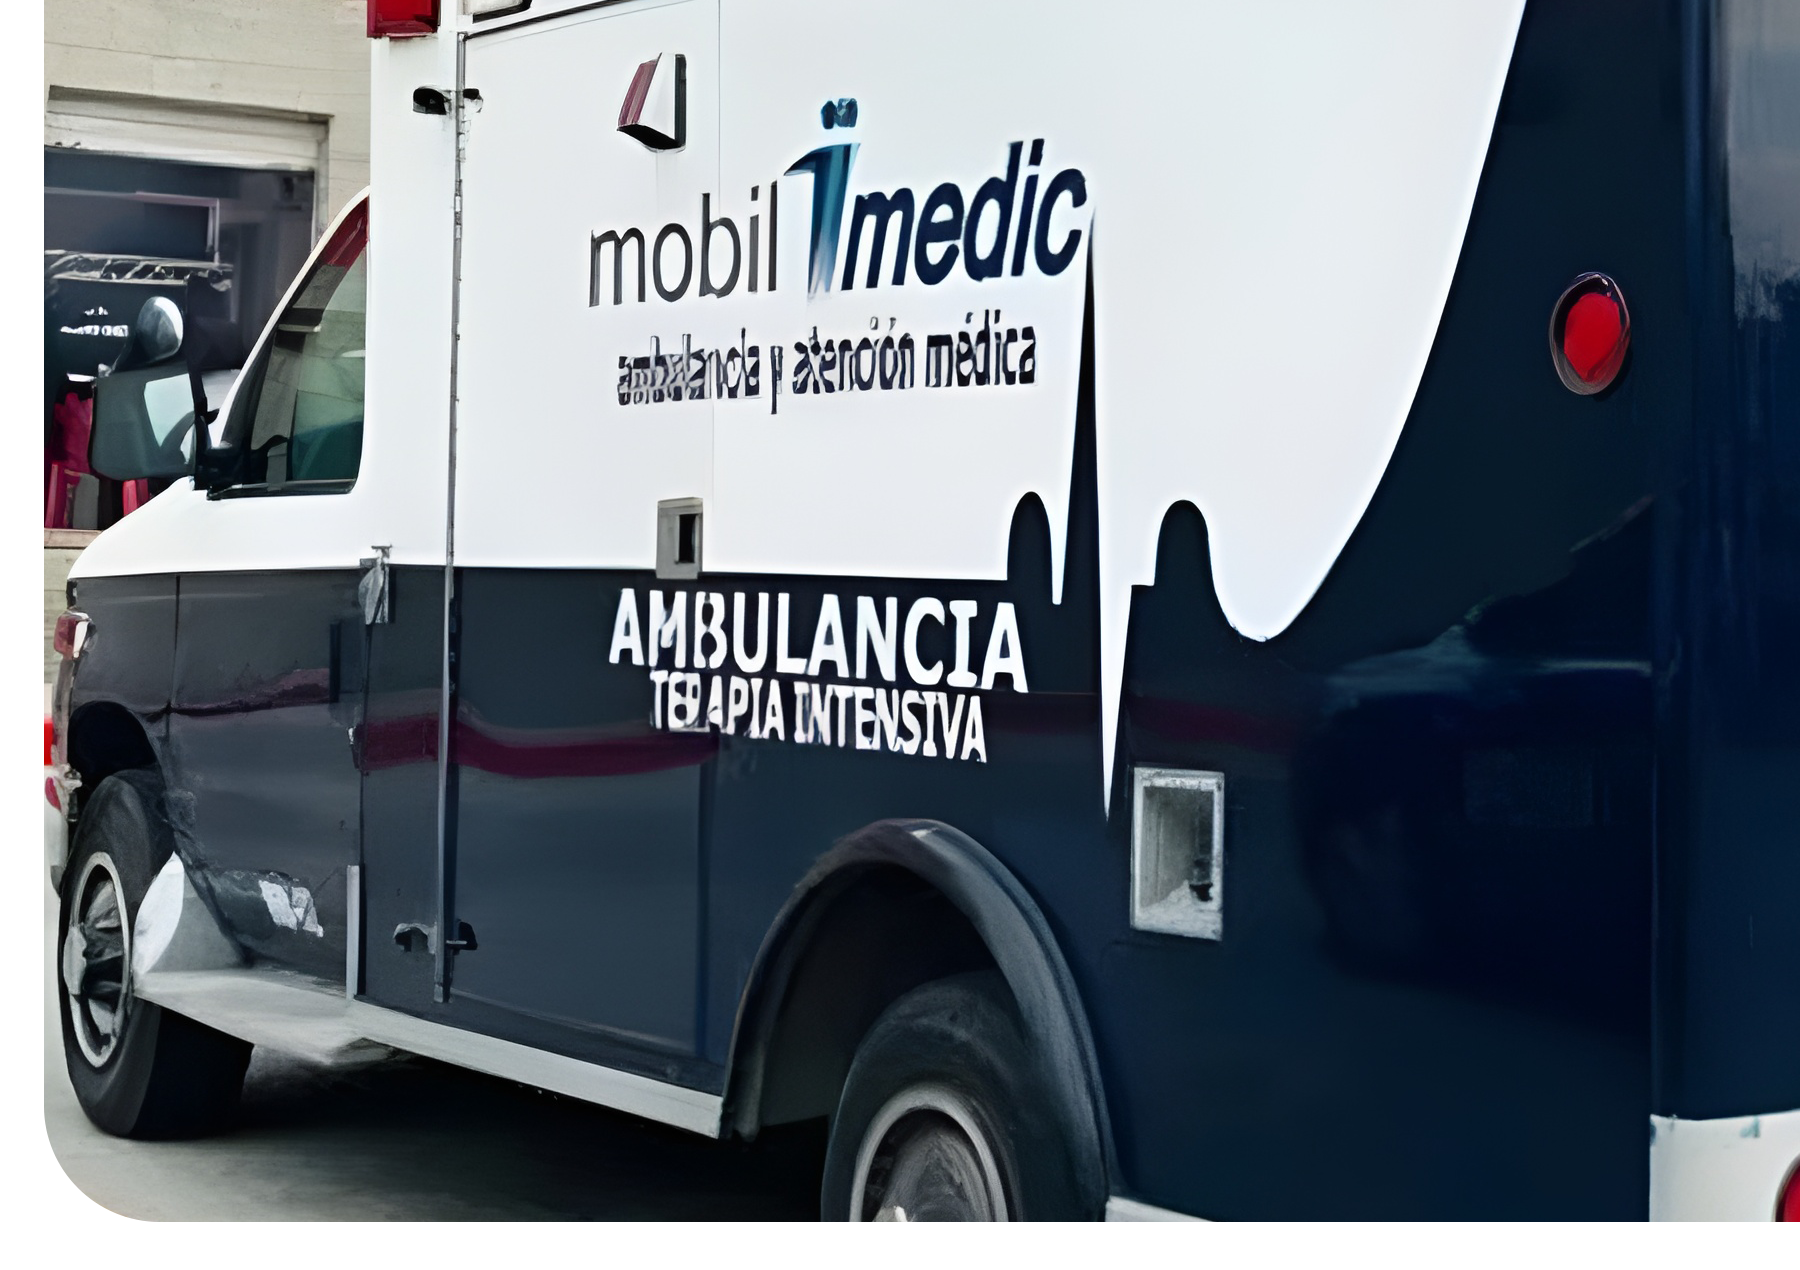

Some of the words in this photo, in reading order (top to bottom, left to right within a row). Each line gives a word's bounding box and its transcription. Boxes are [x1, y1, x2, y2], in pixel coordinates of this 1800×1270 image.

[608, 587, 1029, 693] AMBULANCIA
[649, 670, 785, 742] TERAPIA
[794, 681, 988, 764] INTENSIVA
